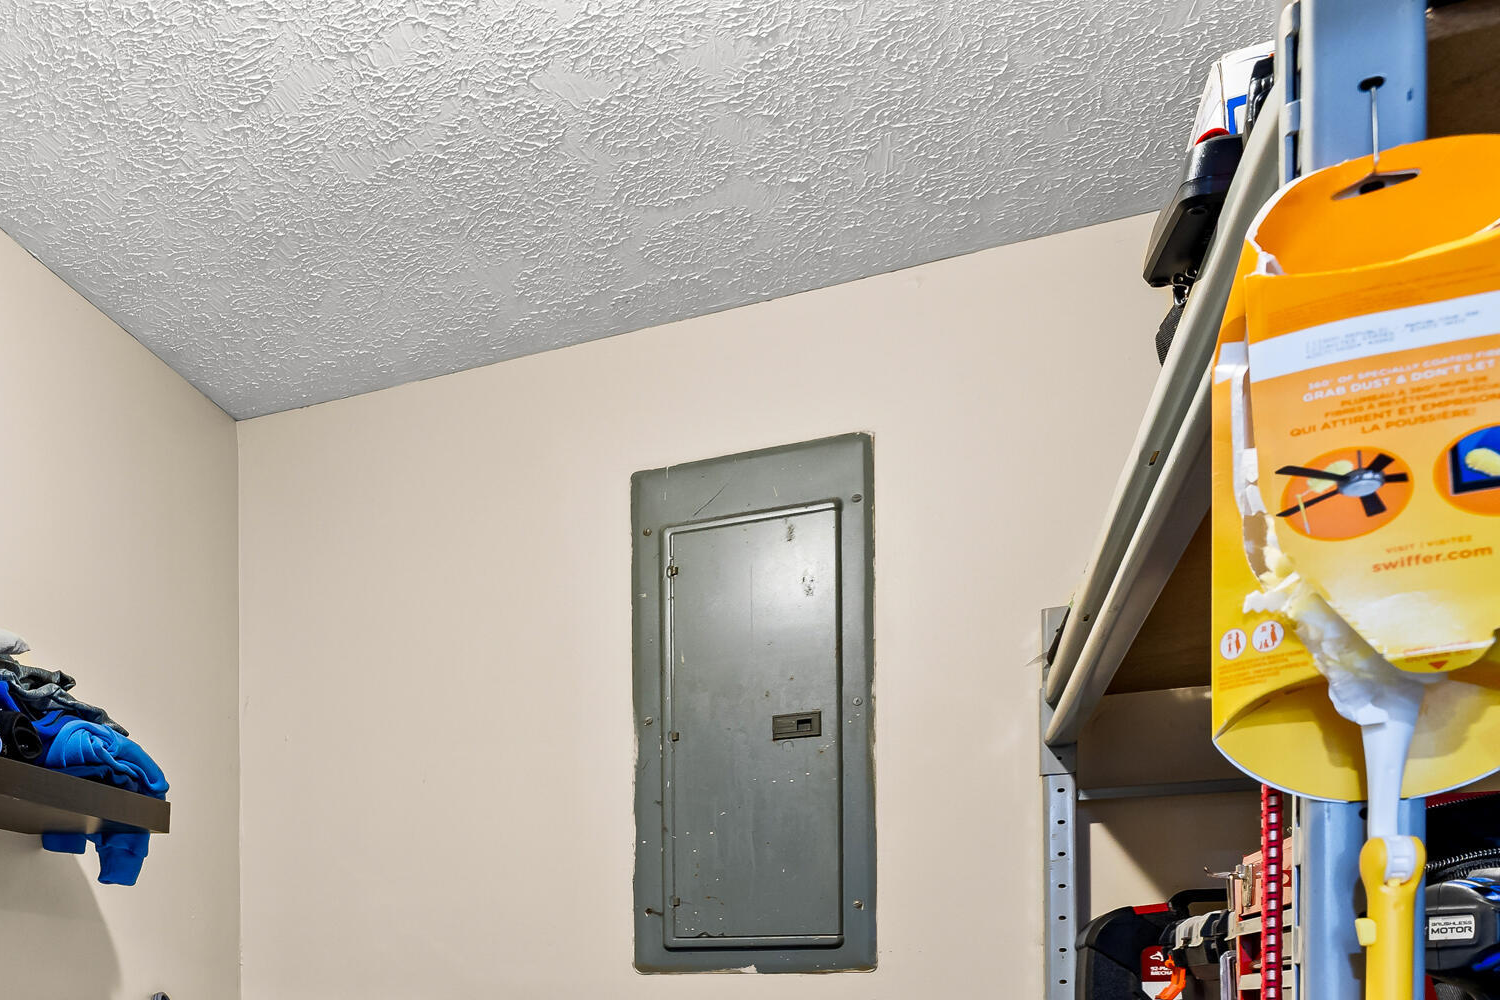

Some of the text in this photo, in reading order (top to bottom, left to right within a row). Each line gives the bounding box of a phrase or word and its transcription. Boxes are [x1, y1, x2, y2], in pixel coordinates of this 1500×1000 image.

[1303, 385, 1346, 402] GRAB
[1350, 376, 1391, 393] DUST
[1396, 374, 1407, 384] &
[1465, 359, 1495, 372] LET
[1289, 424, 1316, 437] QUI
[1320, 408, 1393, 431] ATTIRENT
[1398, 405, 1416, 416] ET
[1361, 424, 1380, 434] LA
[1372, 544, 1493, 573] swiffer.com
[1431, 926, 1473, 934] MOTOR
